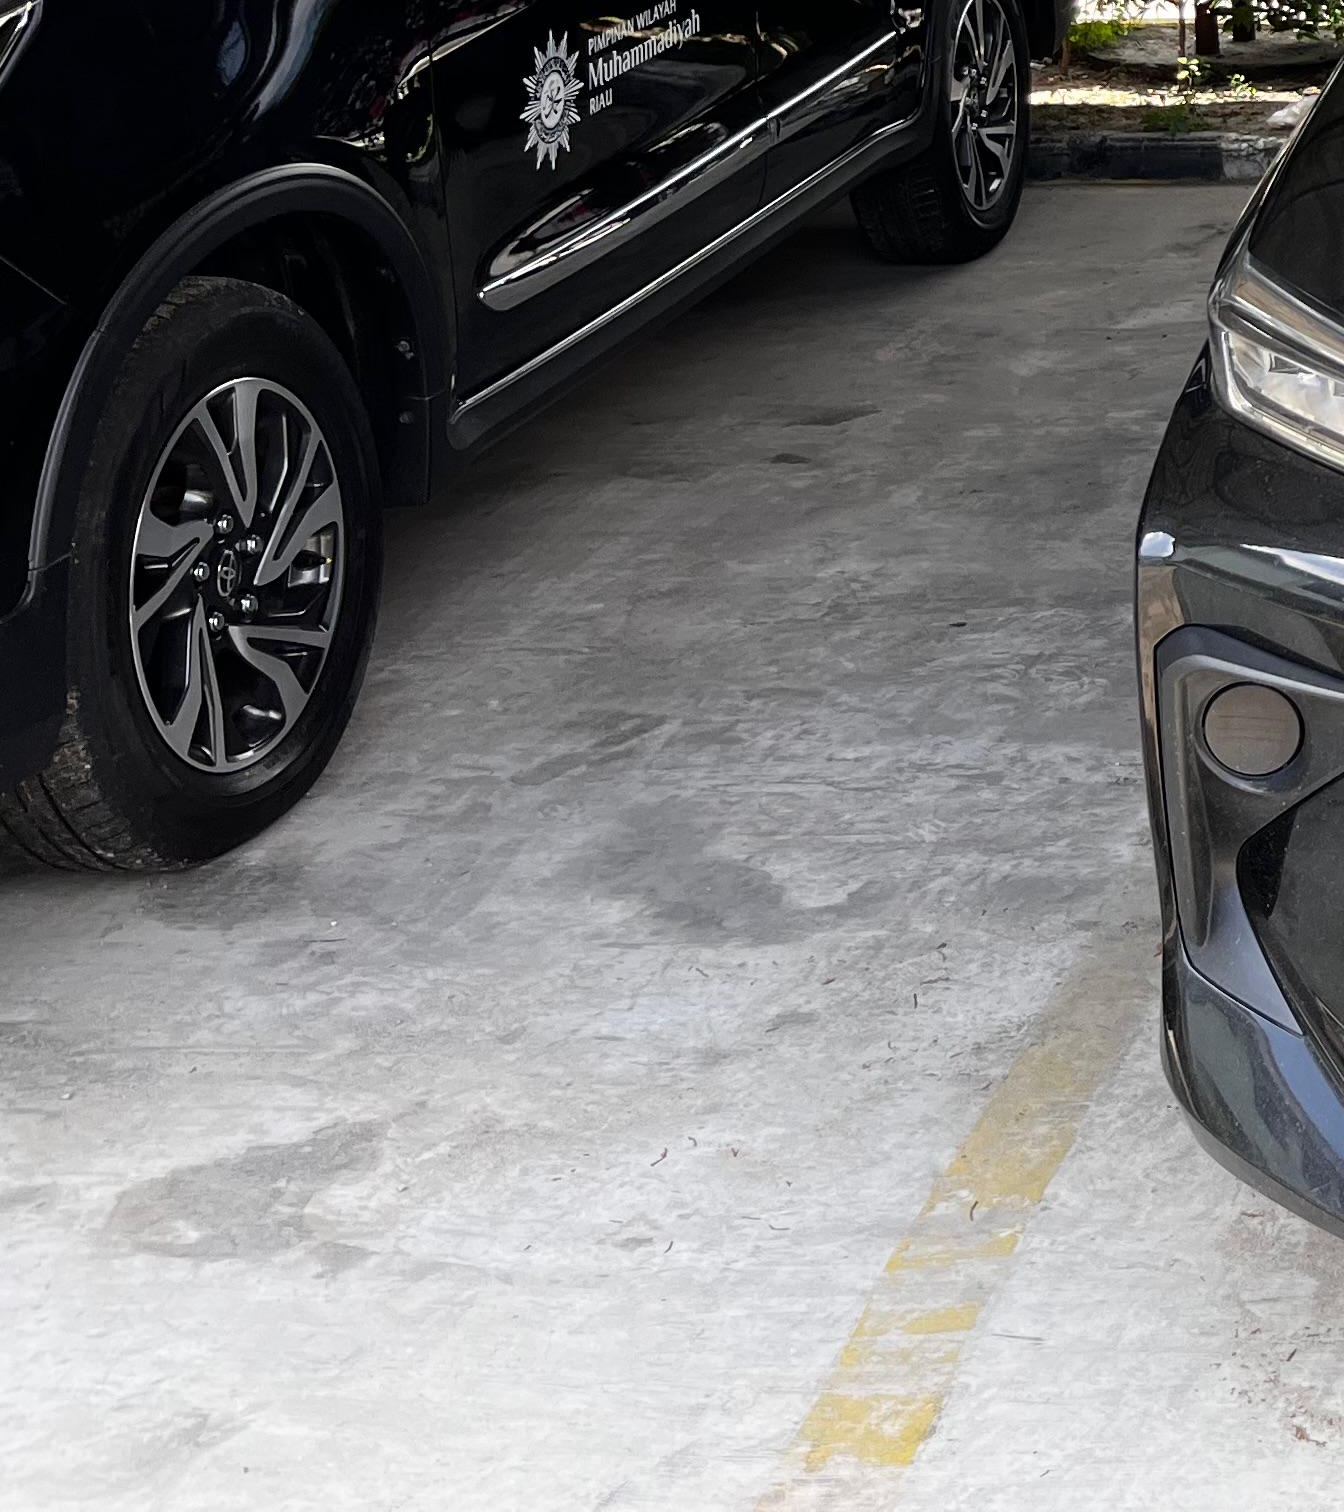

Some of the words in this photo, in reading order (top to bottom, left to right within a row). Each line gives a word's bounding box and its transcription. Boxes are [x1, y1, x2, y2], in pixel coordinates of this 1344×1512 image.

[588, 19, 634, 56] PIMPINAN
[588, 8, 701, 91] Muhammadiyah
[589, 88, 613, 116] RIAU
